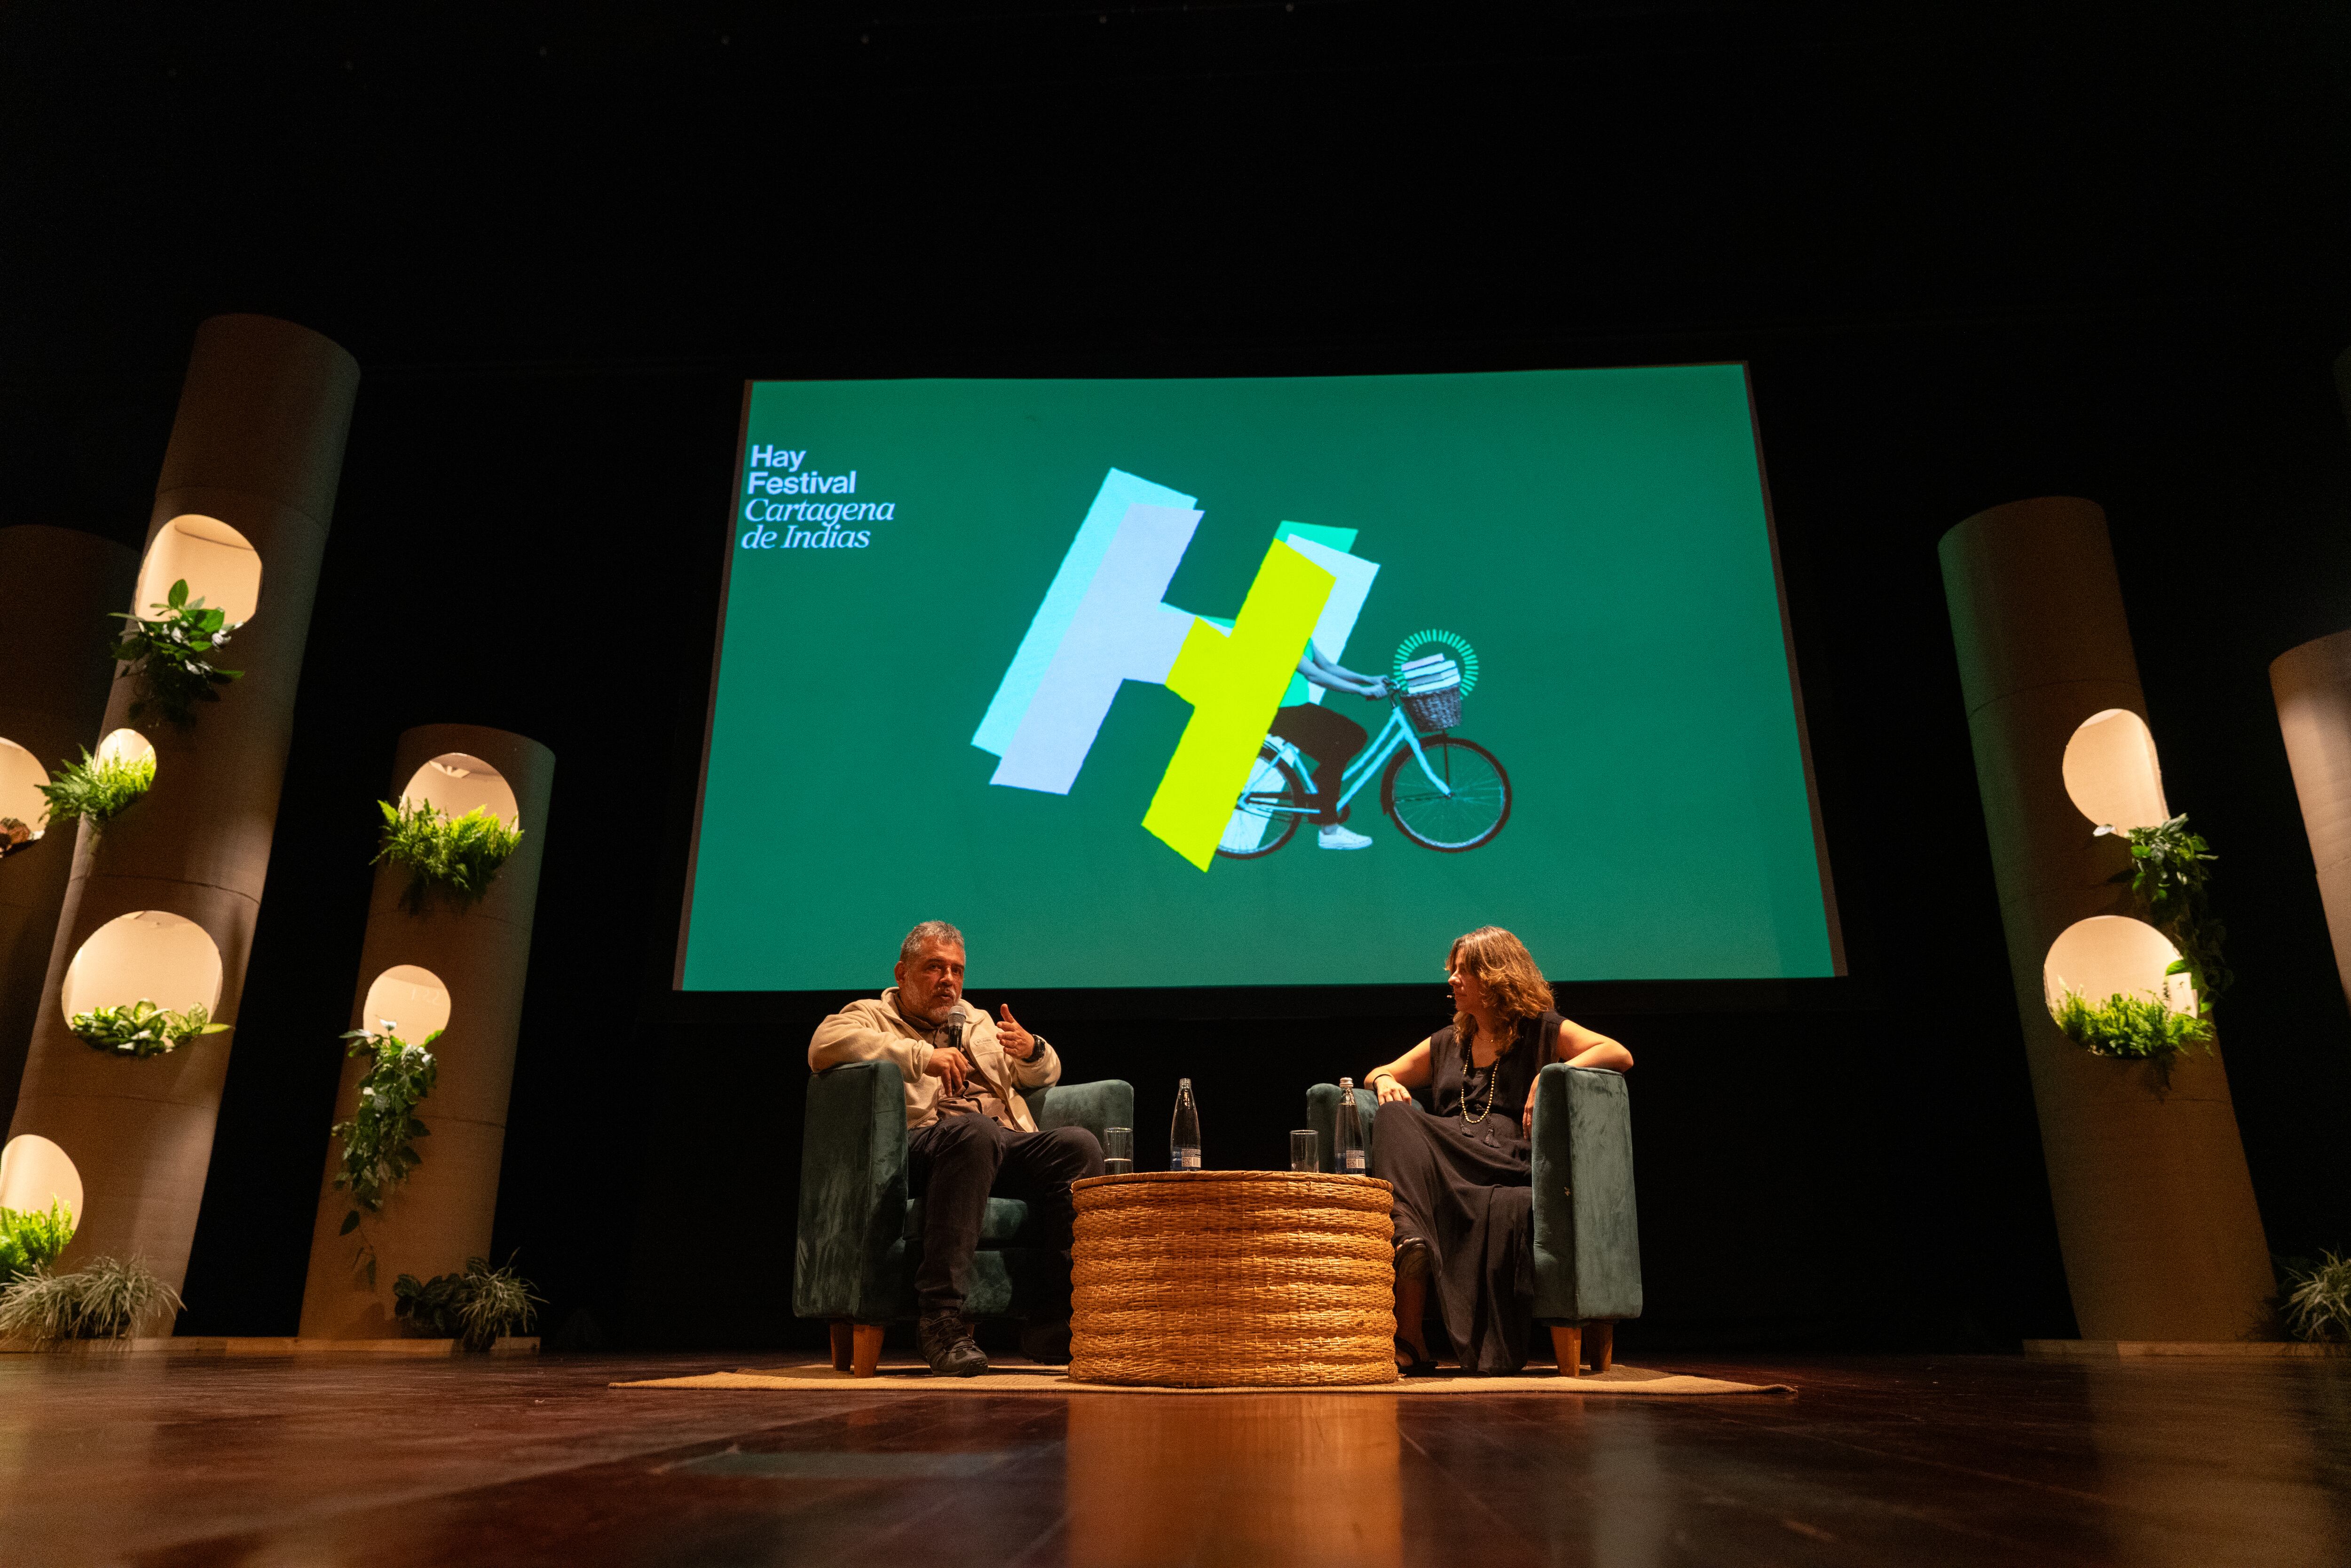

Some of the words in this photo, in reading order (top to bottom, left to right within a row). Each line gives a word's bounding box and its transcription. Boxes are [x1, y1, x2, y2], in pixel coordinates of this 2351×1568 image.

[750, 445, 806, 472] Hay
[748, 471, 857, 494] Festival
[745, 498, 895, 526] Cartagena
[741, 524, 777, 549] de
[780, 524, 871, 549] Indias
